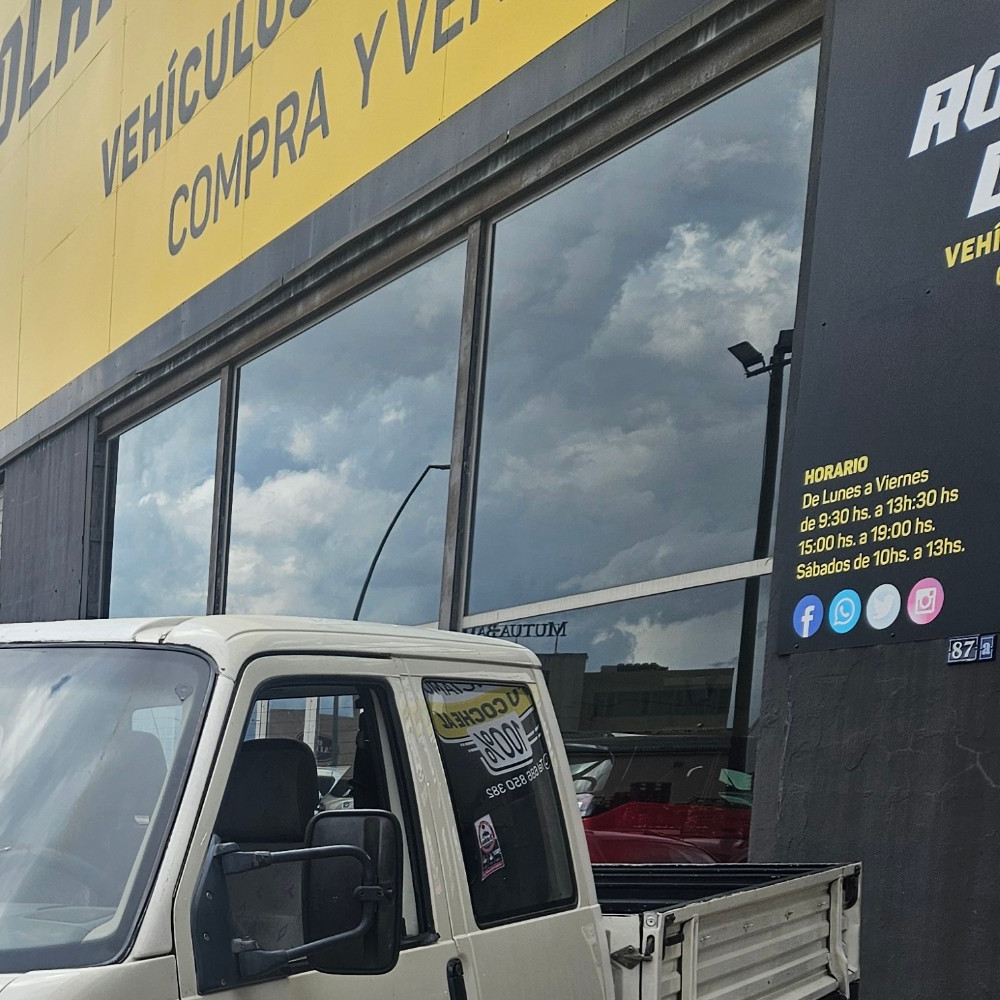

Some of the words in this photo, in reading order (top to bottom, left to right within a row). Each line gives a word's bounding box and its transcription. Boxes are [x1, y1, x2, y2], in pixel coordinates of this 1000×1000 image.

[168, 66, 330, 257] COMPRA
[353, 10, 388, 109] Y
[801, 493, 820, 510] De
[822, 485, 862, 506] Lunes
[864, 481, 873, 495] a
[875, 468, 930, 492] Viernes
[803, 455, 869, 486] HORARIO
[800, 516, 816, 533] de
[818, 508, 850, 530] 9:30
[851, 504, 872, 522] hs.
[874, 504, 884, 518] a
[887, 489, 937, 514] 13h:30
[940, 486, 959, 504] hs
[798, 535, 835, 556] 15:00
[837, 531, 857, 550] hs.
[859, 531, 868, 545] a
[871, 520, 912, 542] 19:00
[914, 517, 936, 535] hs.
[796, 555, 851, 580] Sábados
[853, 553, 871, 571] de
[873, 547, 911, 567] 10hs.
[913, 546, 923, 560] a
[926, 537, 966, 558] 13hs.
[951, 639, 976, 659] 87
